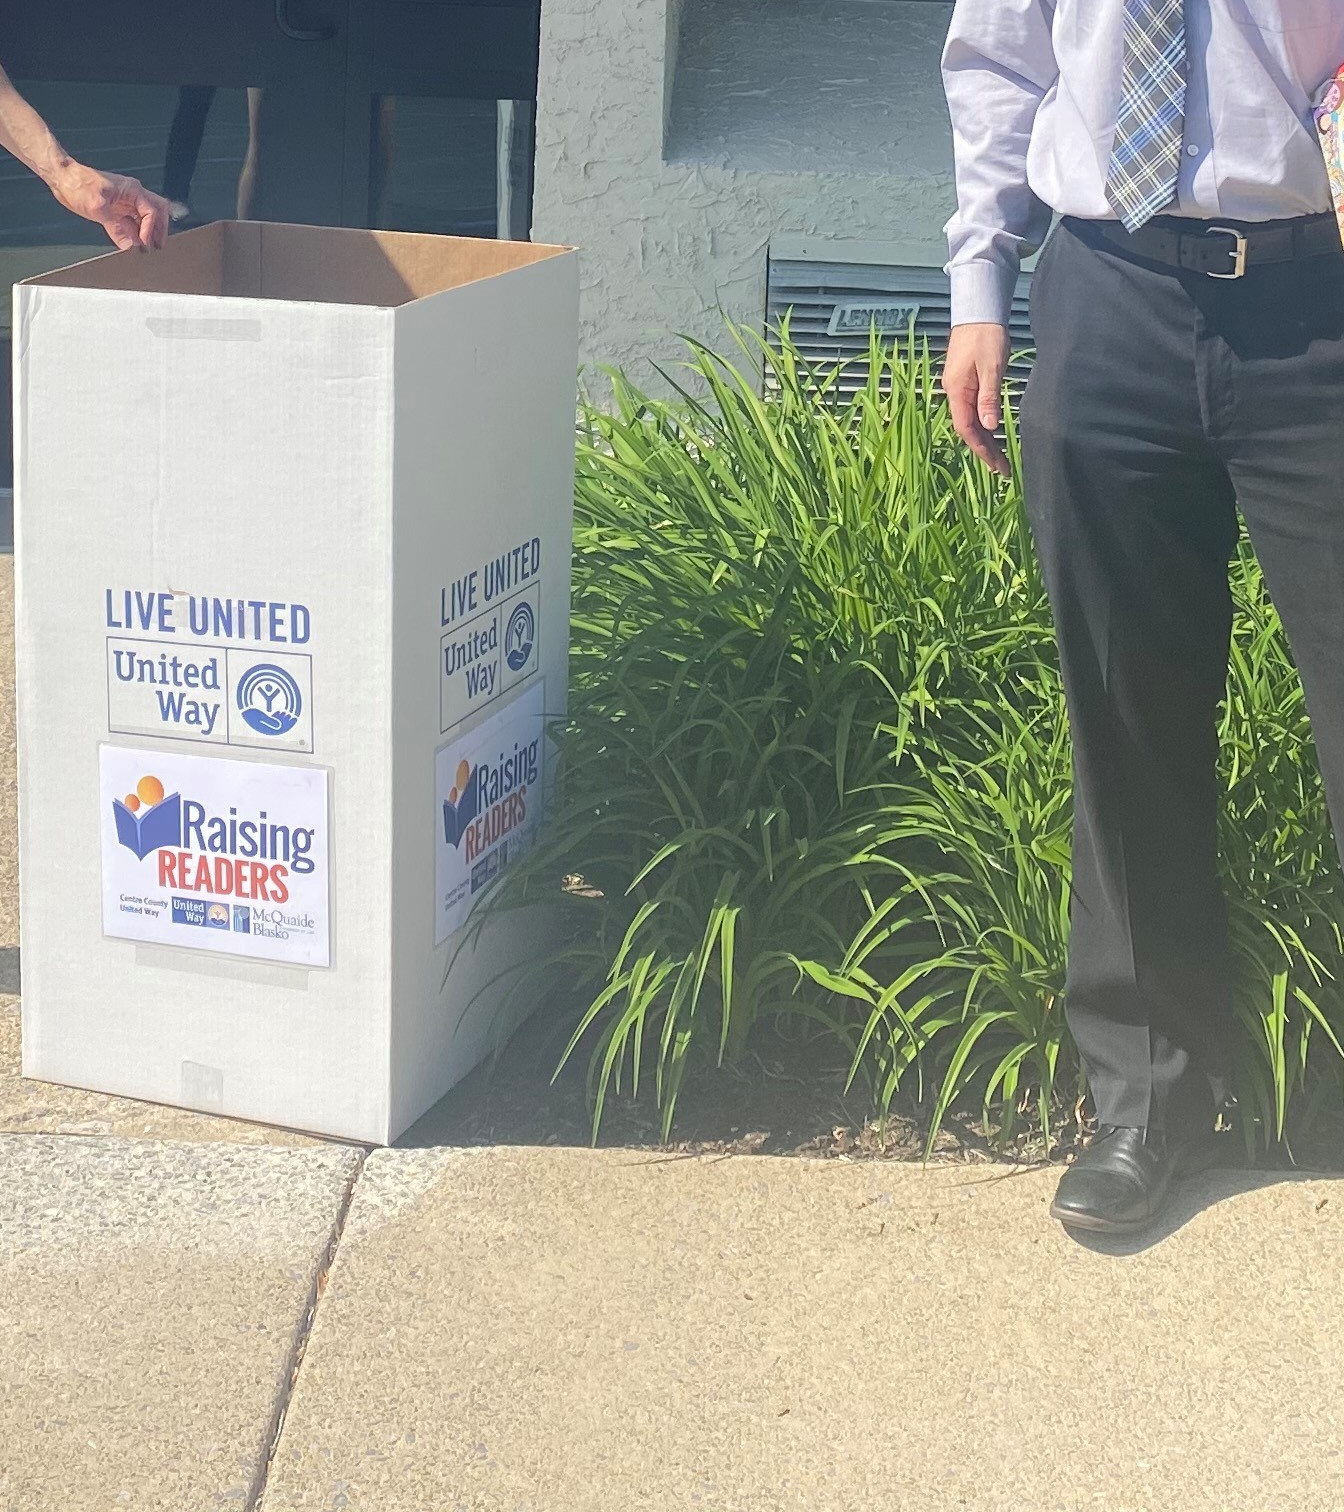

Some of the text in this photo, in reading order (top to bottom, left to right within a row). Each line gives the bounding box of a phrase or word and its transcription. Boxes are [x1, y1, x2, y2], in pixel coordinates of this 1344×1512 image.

[836, 308, 914, 328] LENNOX
[441, 537, 540, 627] LIVE UNITED
[106, 589, 310, 644] LIVE UNITED
[444, 618, 498, 676] United
[113, 650, 220, 690] United
[466, 660, 498, 699] Way
[156, 690, 221, 735] Way
[479, 738, 538, 814] Raising
[183, 799, 315, 874] Raising
[465, 785, 527, 864] READERS
[158, 849, 289, 904] READERS
[120, 894, 142, 904] Centre
[120, 904, 159, 918] United Way
[173, 899, 204, 912] United
[185, 910, 204, 925] Way
[253, 907, 315, 928] McQuaide
[253, 922, 289, 940] Blasko
